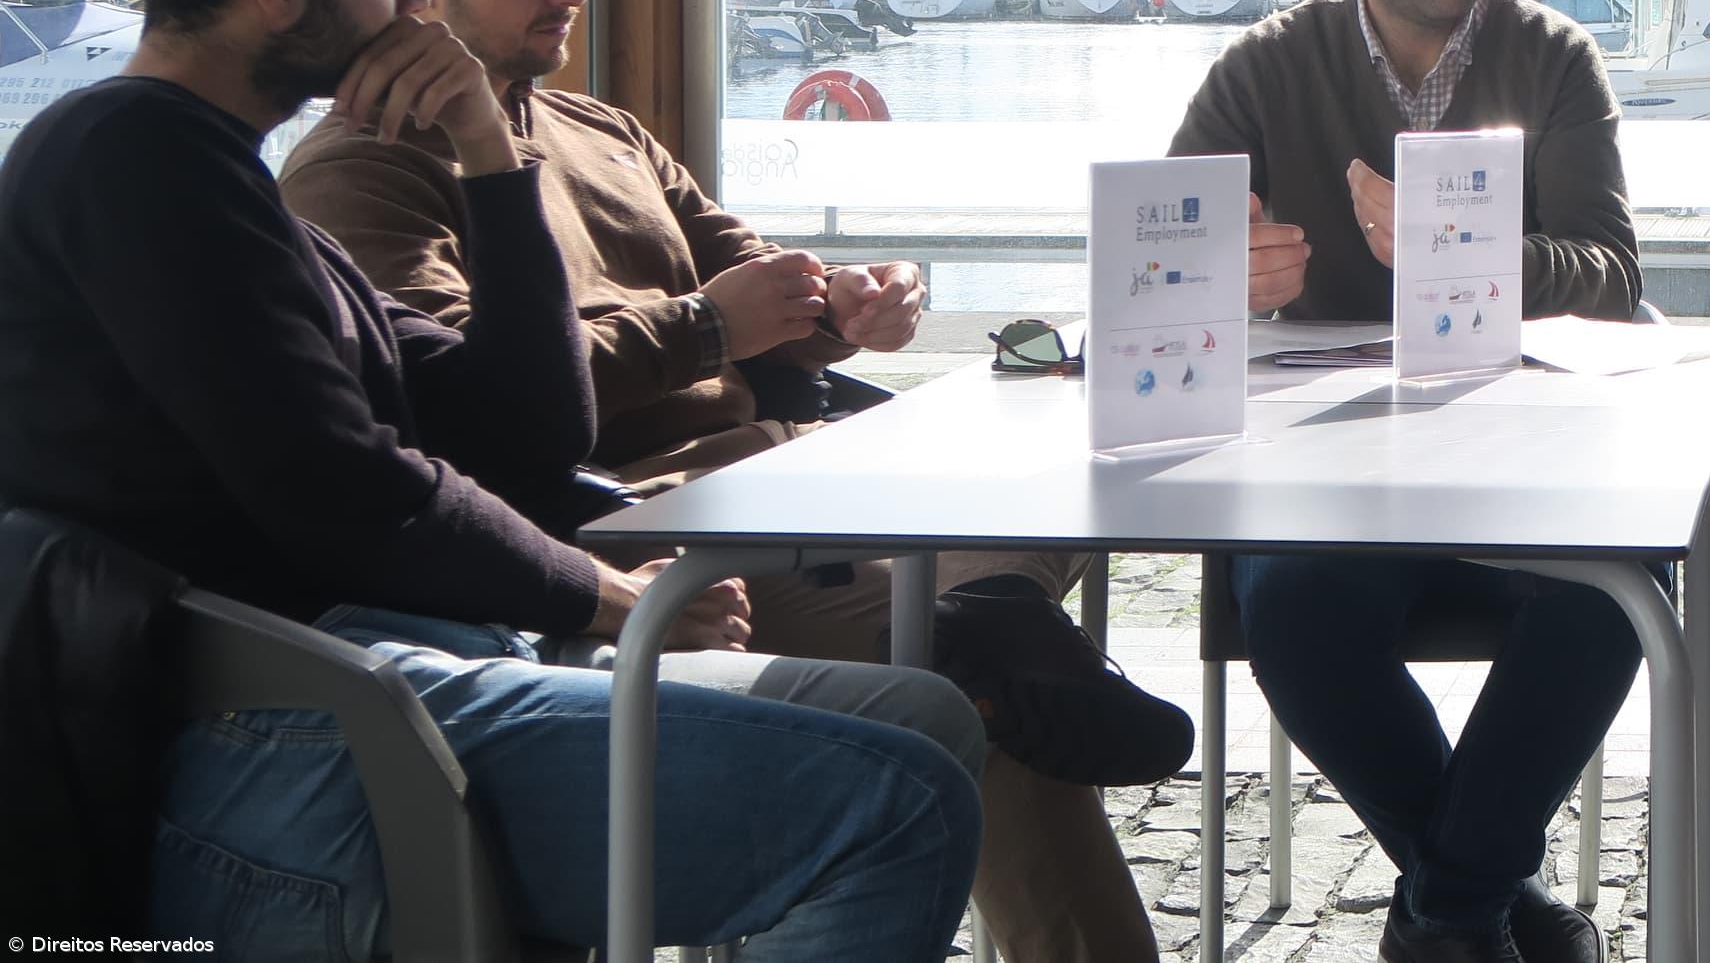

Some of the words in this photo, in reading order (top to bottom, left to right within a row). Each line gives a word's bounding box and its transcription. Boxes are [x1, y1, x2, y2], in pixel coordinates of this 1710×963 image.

[1436, 175, 1470, 192] SAIL
[1436, 194, 1493, 210] Employment
[1136, 204, 1180, 224] SAIL
[1136, 226, 1208, 245] Employment
